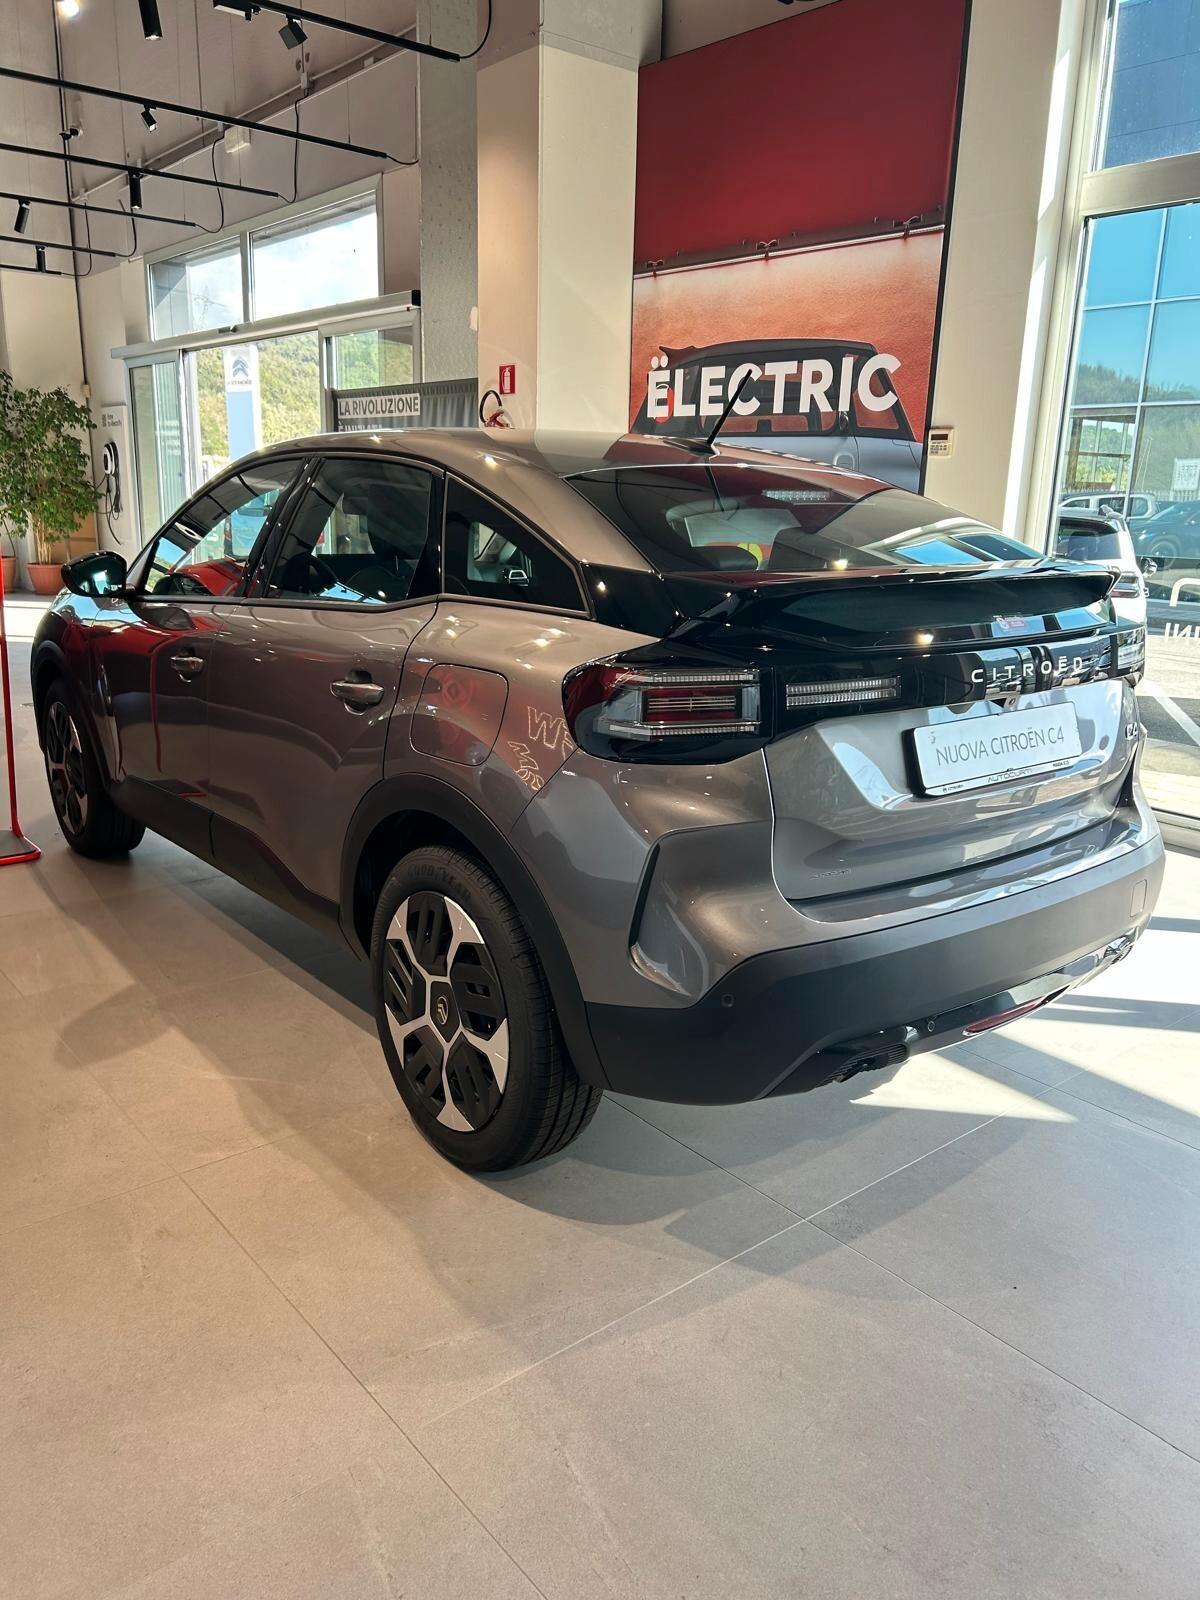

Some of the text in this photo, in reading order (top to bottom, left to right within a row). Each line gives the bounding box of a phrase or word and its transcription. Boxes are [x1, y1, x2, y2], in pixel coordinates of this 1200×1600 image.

[340, 396, 419, 416] LA RIVOLUZIONE
[647, 353, 902, 419] ËLECTRIC
[936, 726, 1065, 767] NUOVA CITROËN C4
